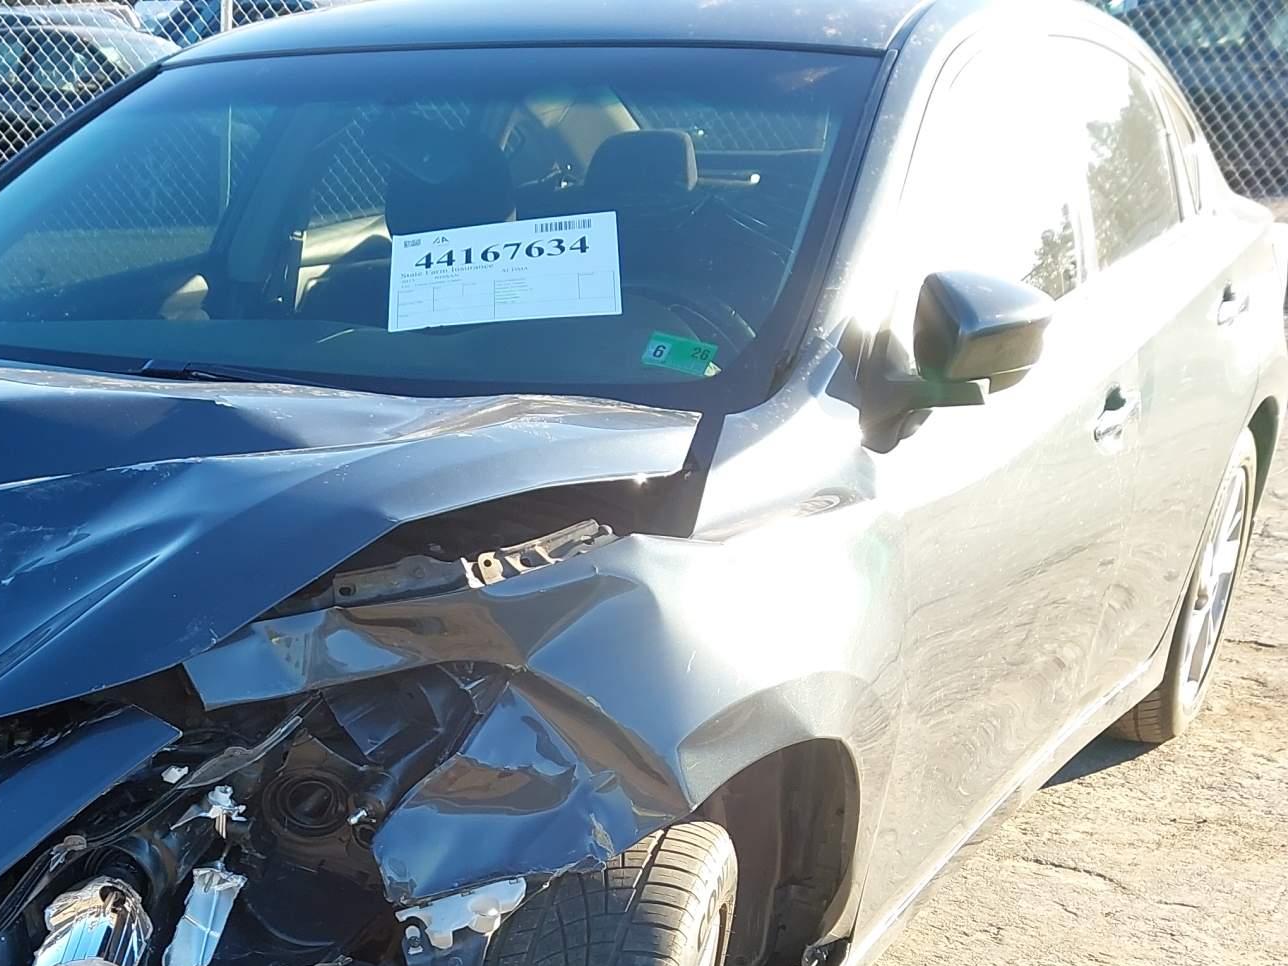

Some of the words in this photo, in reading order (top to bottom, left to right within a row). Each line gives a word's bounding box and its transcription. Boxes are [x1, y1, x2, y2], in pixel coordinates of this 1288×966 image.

[414, 235, 590, 270] 44167634
[652, 344, 667, 359] 6
[691, 346, 711, 361] 26
